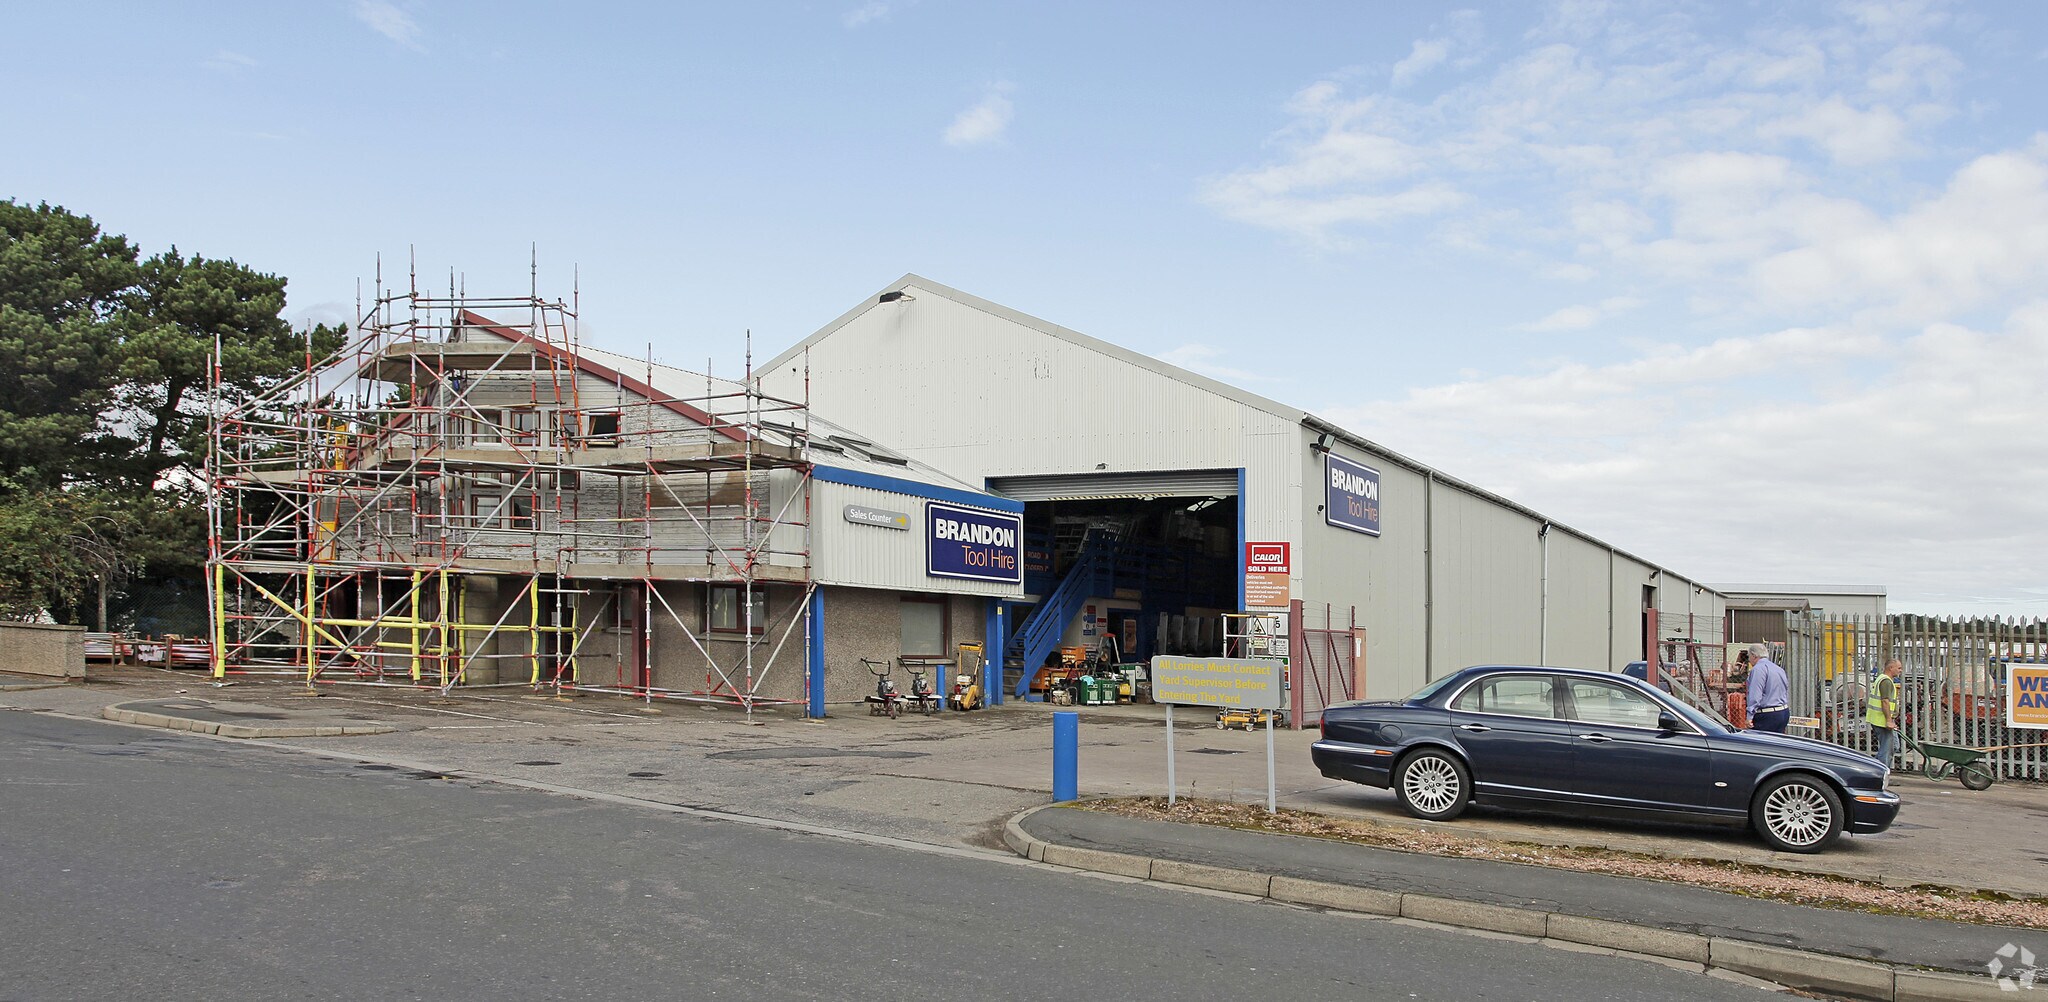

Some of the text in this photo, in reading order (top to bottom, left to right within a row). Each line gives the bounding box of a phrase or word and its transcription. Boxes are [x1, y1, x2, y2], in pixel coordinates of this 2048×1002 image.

[1332, 468, 1377, 501] BRANDON
[850, 508, 892, 523] Sales Counter
[1346, 496, 1378, 522] Tool Hire
[936, 518, 1014, 548] BRANDON
[962, 544, 1014, 570] Tool Hire
[1254, 554, 1281, 562] CALOR
[1159, 660, 1271, 675] All Lorries Must Contact
[1159, 675, 1267, 690] Yard Supervisor Before
[2017, 676, 2048, 692] WE
[1159, 690, 1241, 704] Entering The Yard
